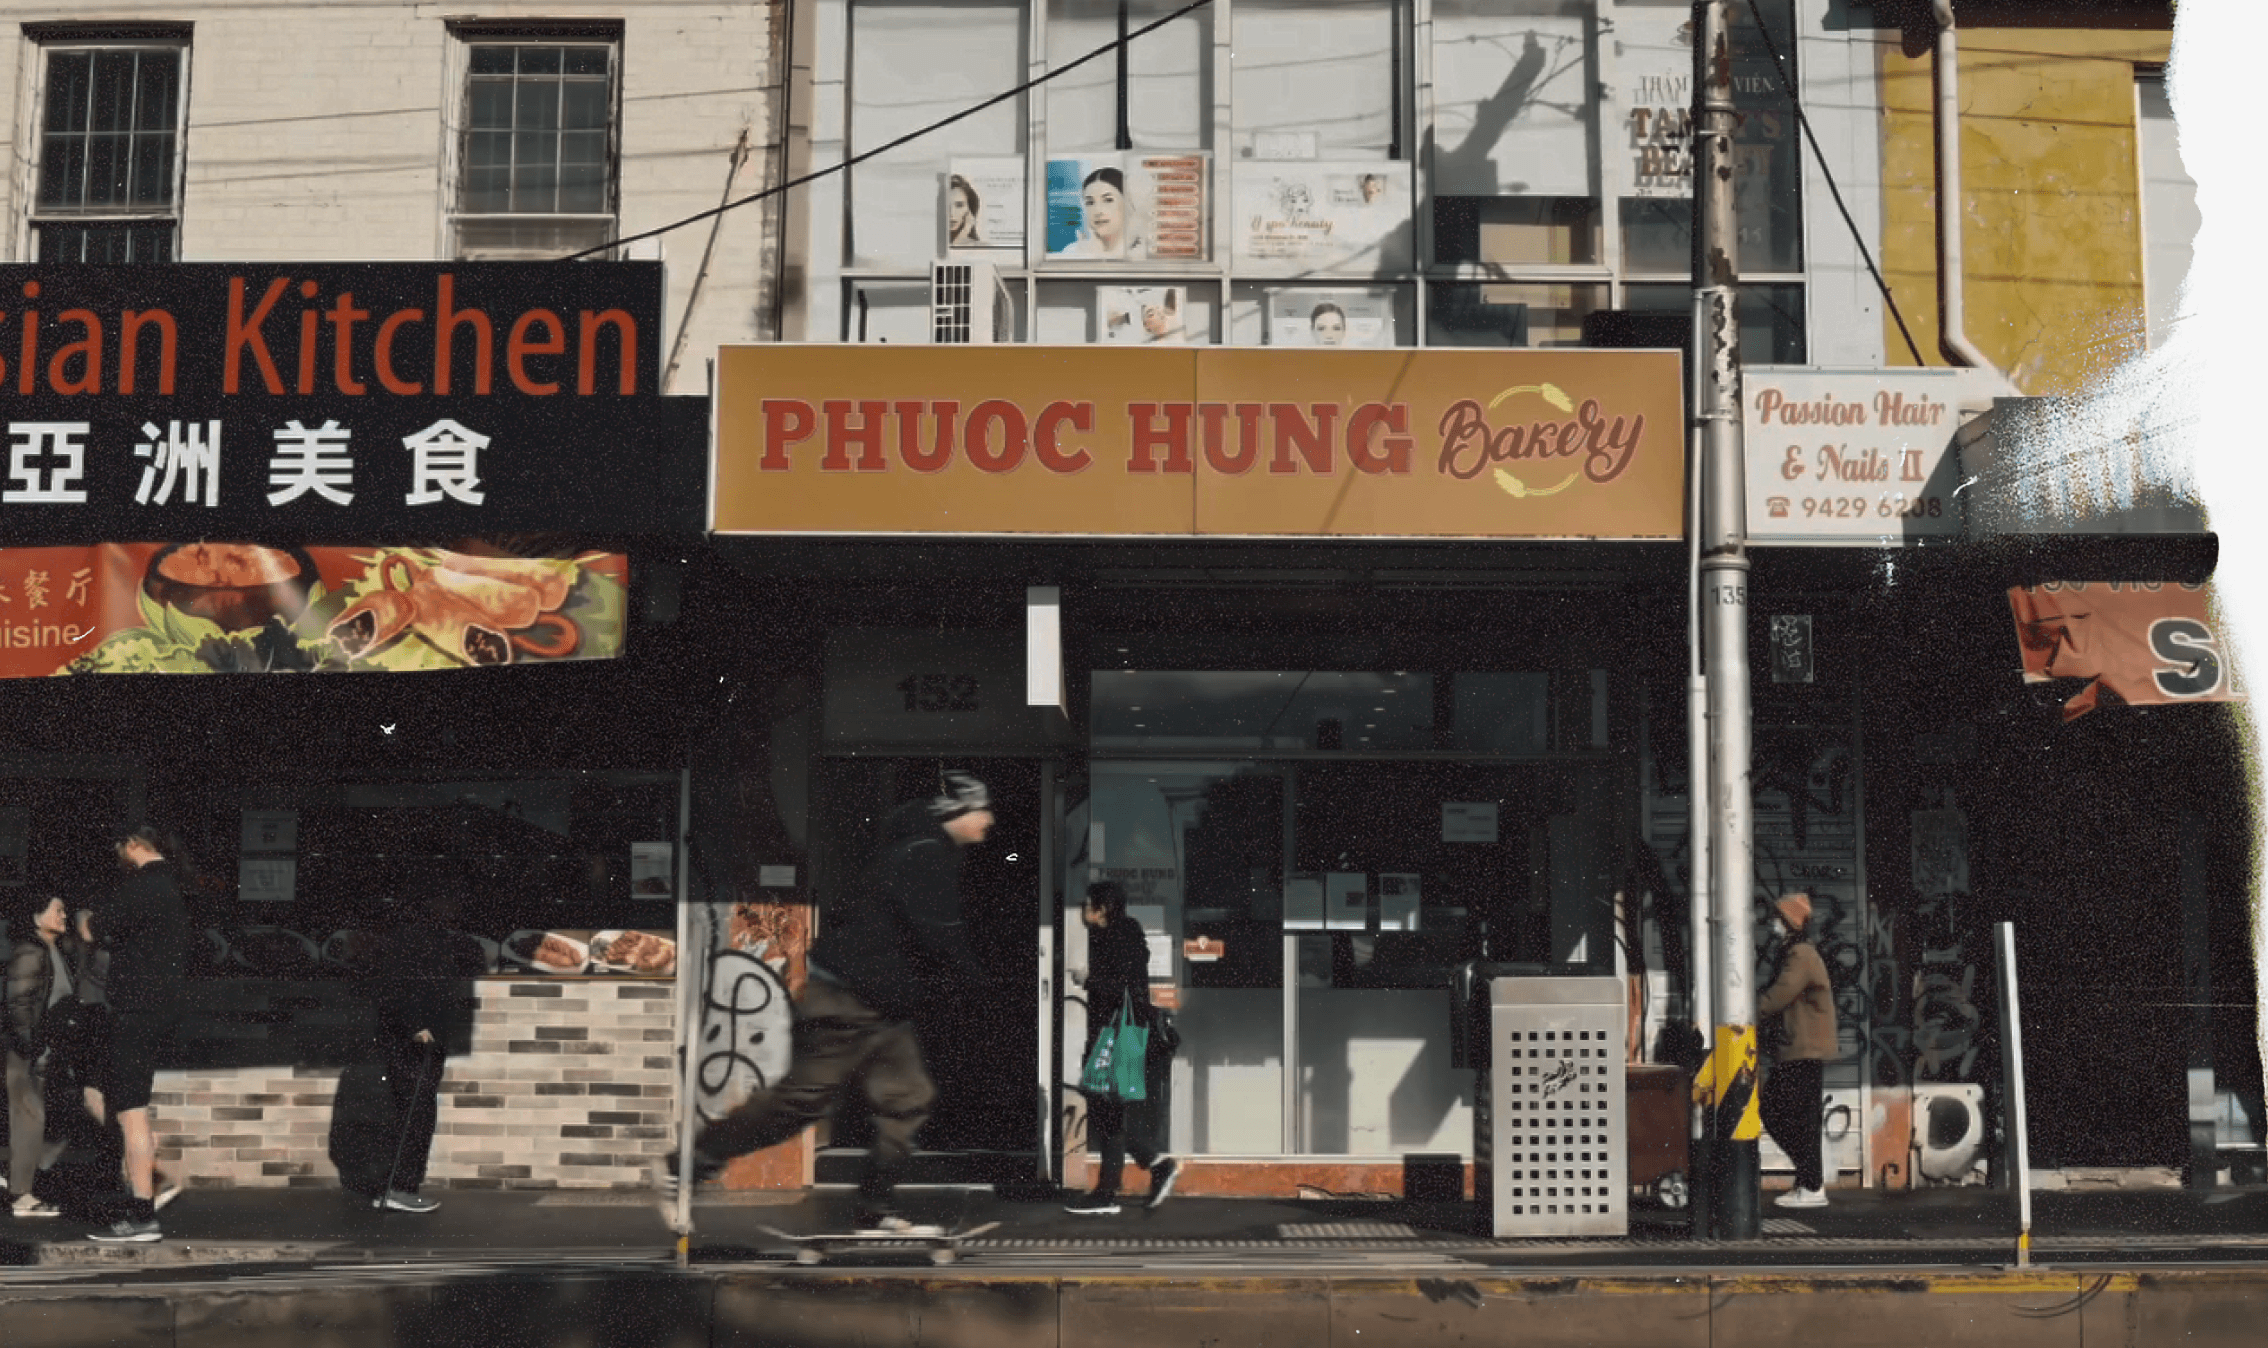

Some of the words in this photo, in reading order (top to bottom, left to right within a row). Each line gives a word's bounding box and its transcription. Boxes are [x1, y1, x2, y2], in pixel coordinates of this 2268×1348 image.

[0, 280, 177, 395] ian
[223, 274, 639, 395] Kitchen
[1755, 388, 1867, 426] Passion
[1873, 390, 1946, 426] Hair
[760, 399, 1095, 474] PHUOC
[1126, 402, 1415, 476] HUNG
[1437, 398, 1645, 484] Bakery
[3, 418, 490, 506] 亞洲美食
[1781, 444, 1805, 480] &
[1815, 443, 1889, 481] Nails
[1801, 497, 1867, 518] 9429
[1877, 497, 1943, 518] 6208
[0, 618, 80, 649] isine
[897, 674, 979, 711] 152
